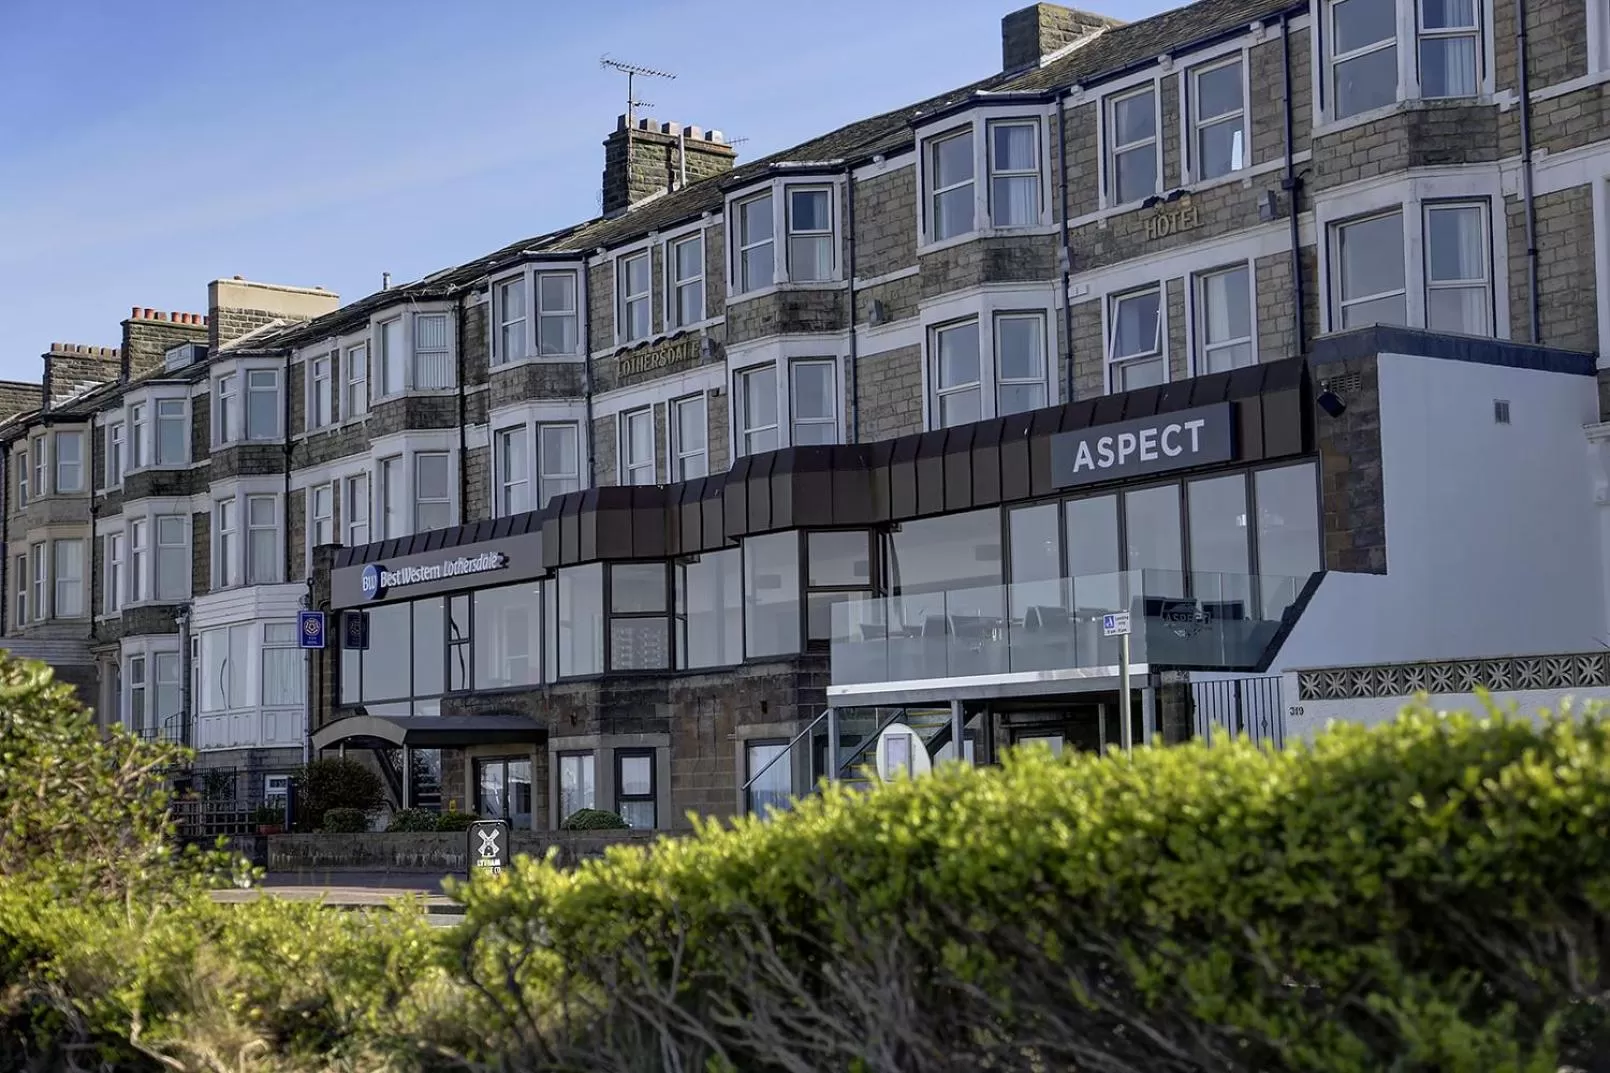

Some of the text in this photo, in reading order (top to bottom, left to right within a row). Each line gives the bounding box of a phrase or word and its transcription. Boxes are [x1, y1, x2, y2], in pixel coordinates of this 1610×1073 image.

[1145, 206, 1203, 241] HOTEL
[1072, 419, 1205, 473] ASPECT
[380, 551, 499, 588] Best Western Lothersdale
[1165, 611, 1212, 625] ASPECT
